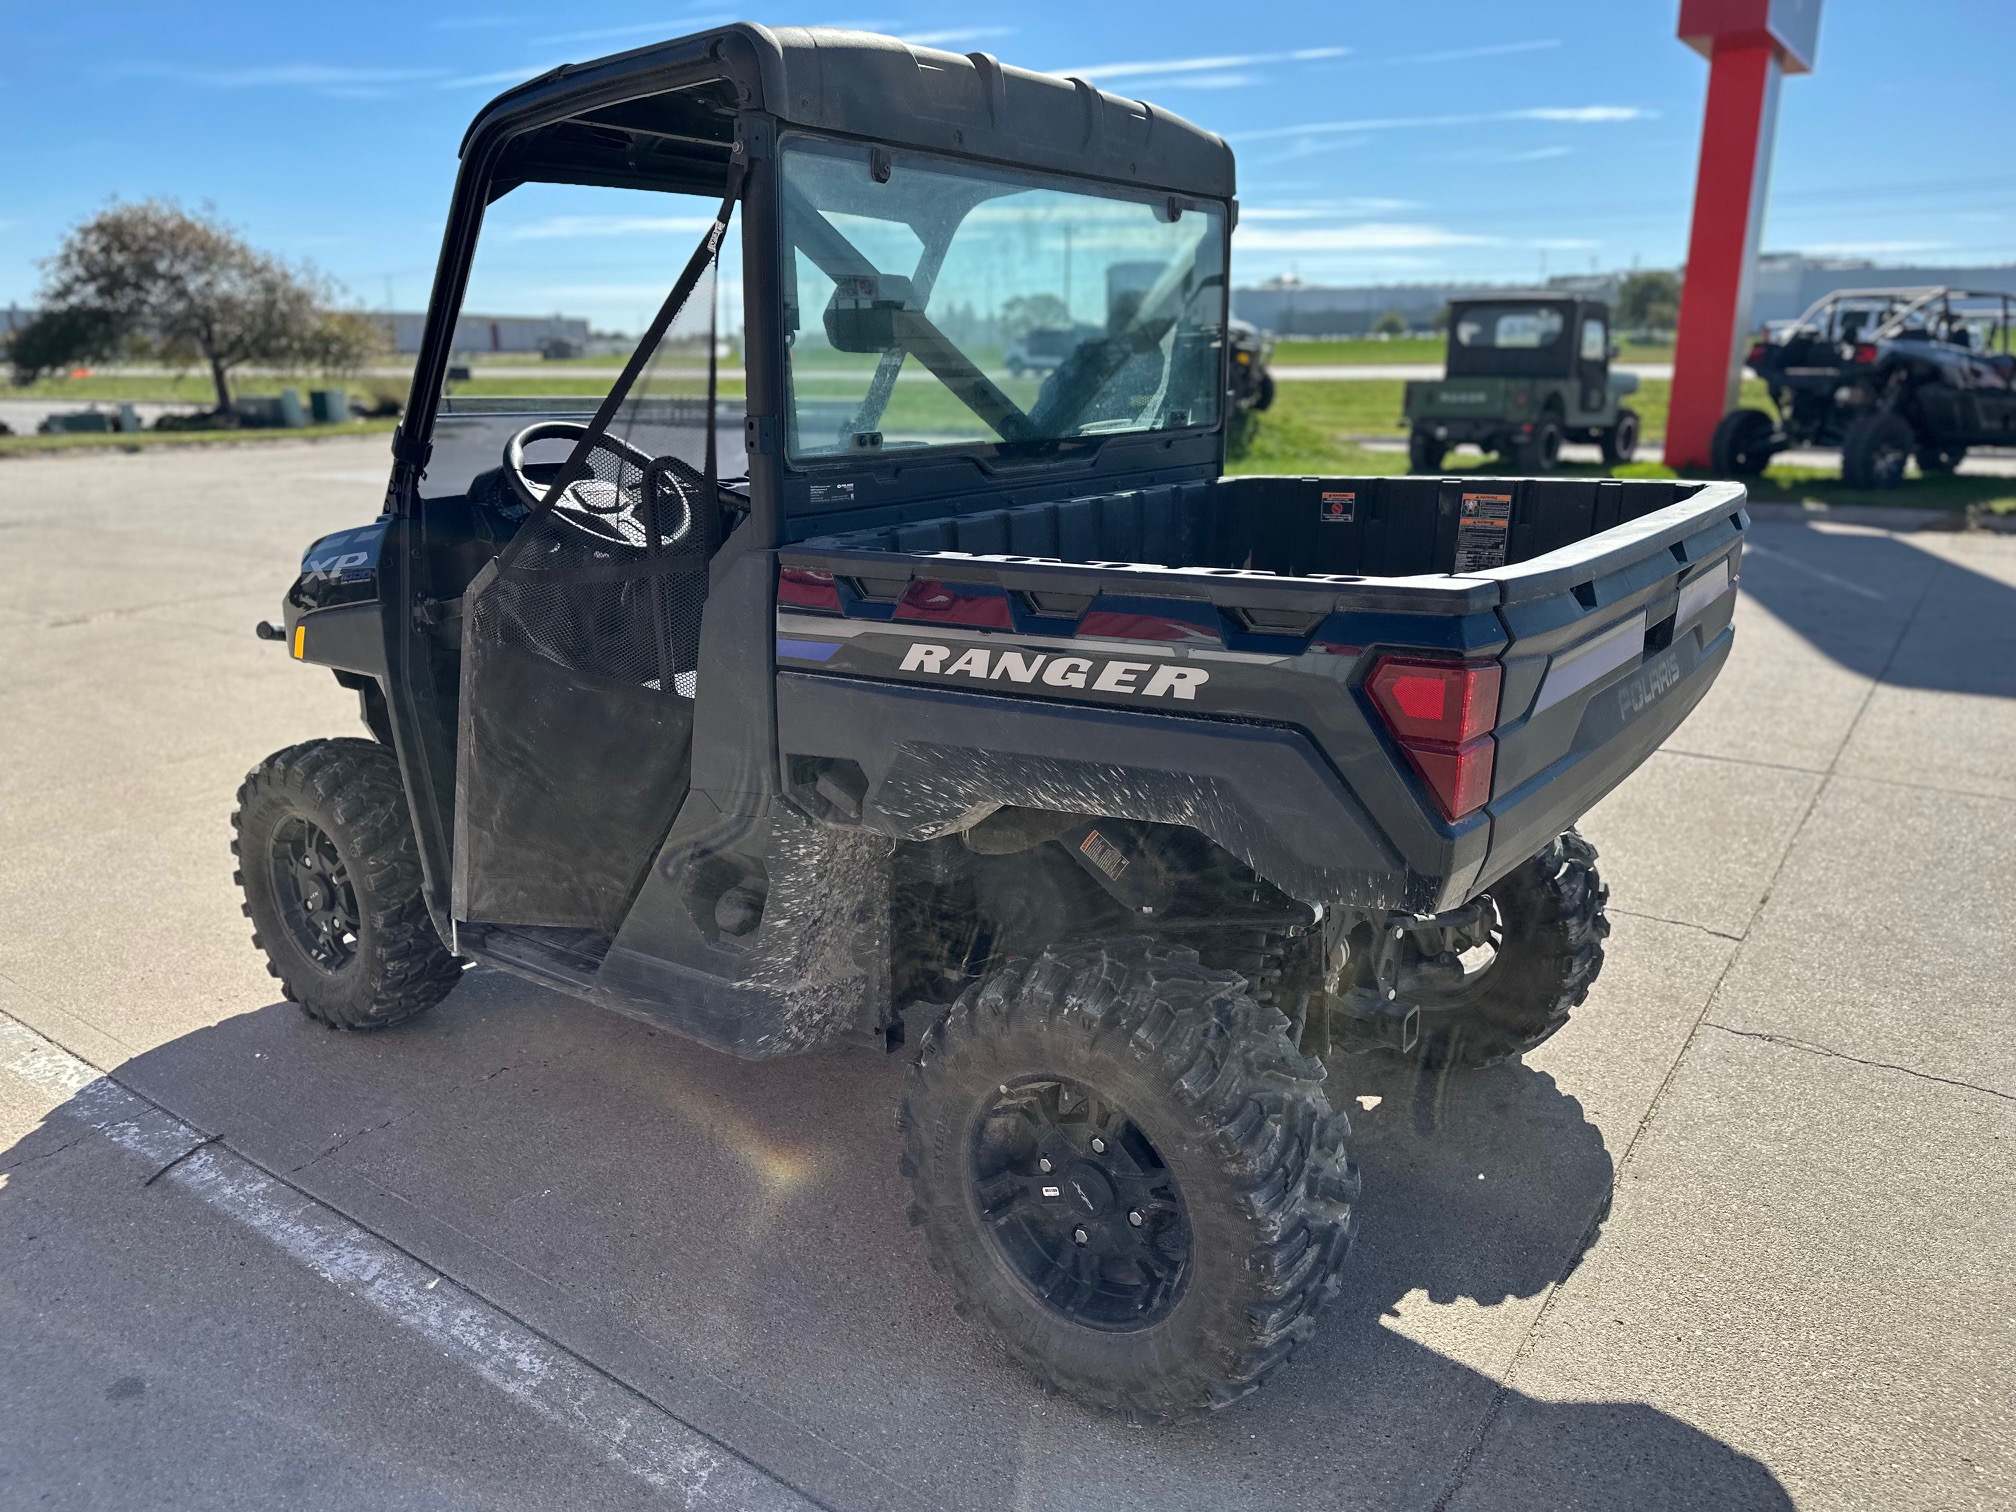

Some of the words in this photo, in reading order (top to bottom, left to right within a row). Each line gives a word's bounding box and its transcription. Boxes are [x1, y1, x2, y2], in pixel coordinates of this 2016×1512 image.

[300, 552, 368, 585] XP
[898, 643, 1210, 700] RANGER
[1618, 652, 1680, 720] POLARIS
